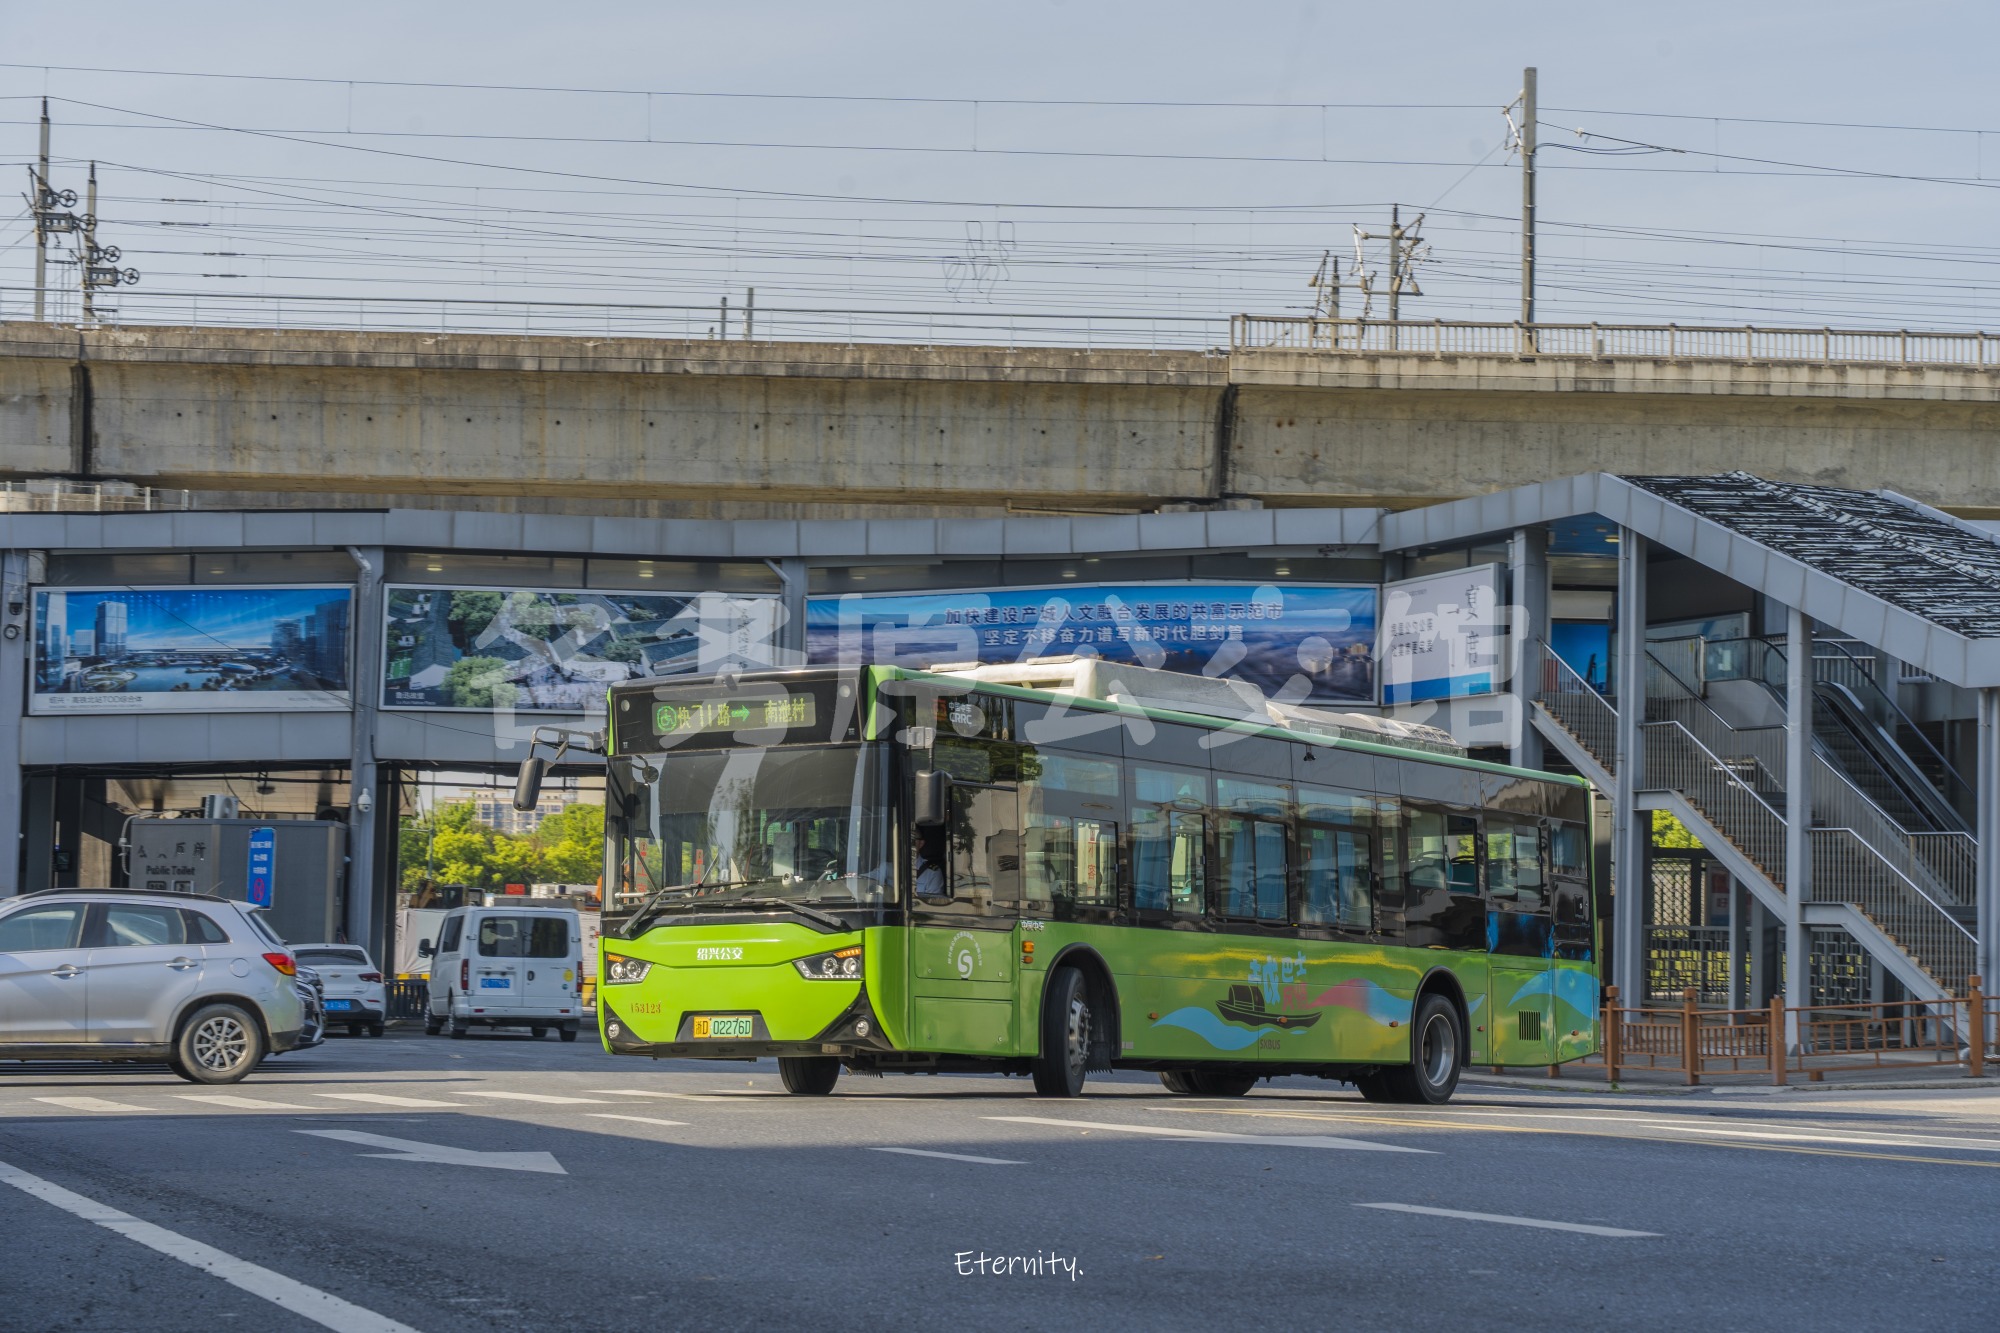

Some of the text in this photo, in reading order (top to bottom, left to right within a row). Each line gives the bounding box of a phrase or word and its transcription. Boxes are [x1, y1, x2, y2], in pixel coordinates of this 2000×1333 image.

[945, 601, 1284, 625] 加快建设产城人文融合发展的共富示范市
[984, 624, 1245, 646] 坚定不移奋力谱写新时代胆剑篇
[949, 712, 973, 725] CRRC
[146, 865, 170, 876] Public
[696, 947, 744, 961] 绍兴公交
[1260, 1039, 1281, 1050] SXBUS
